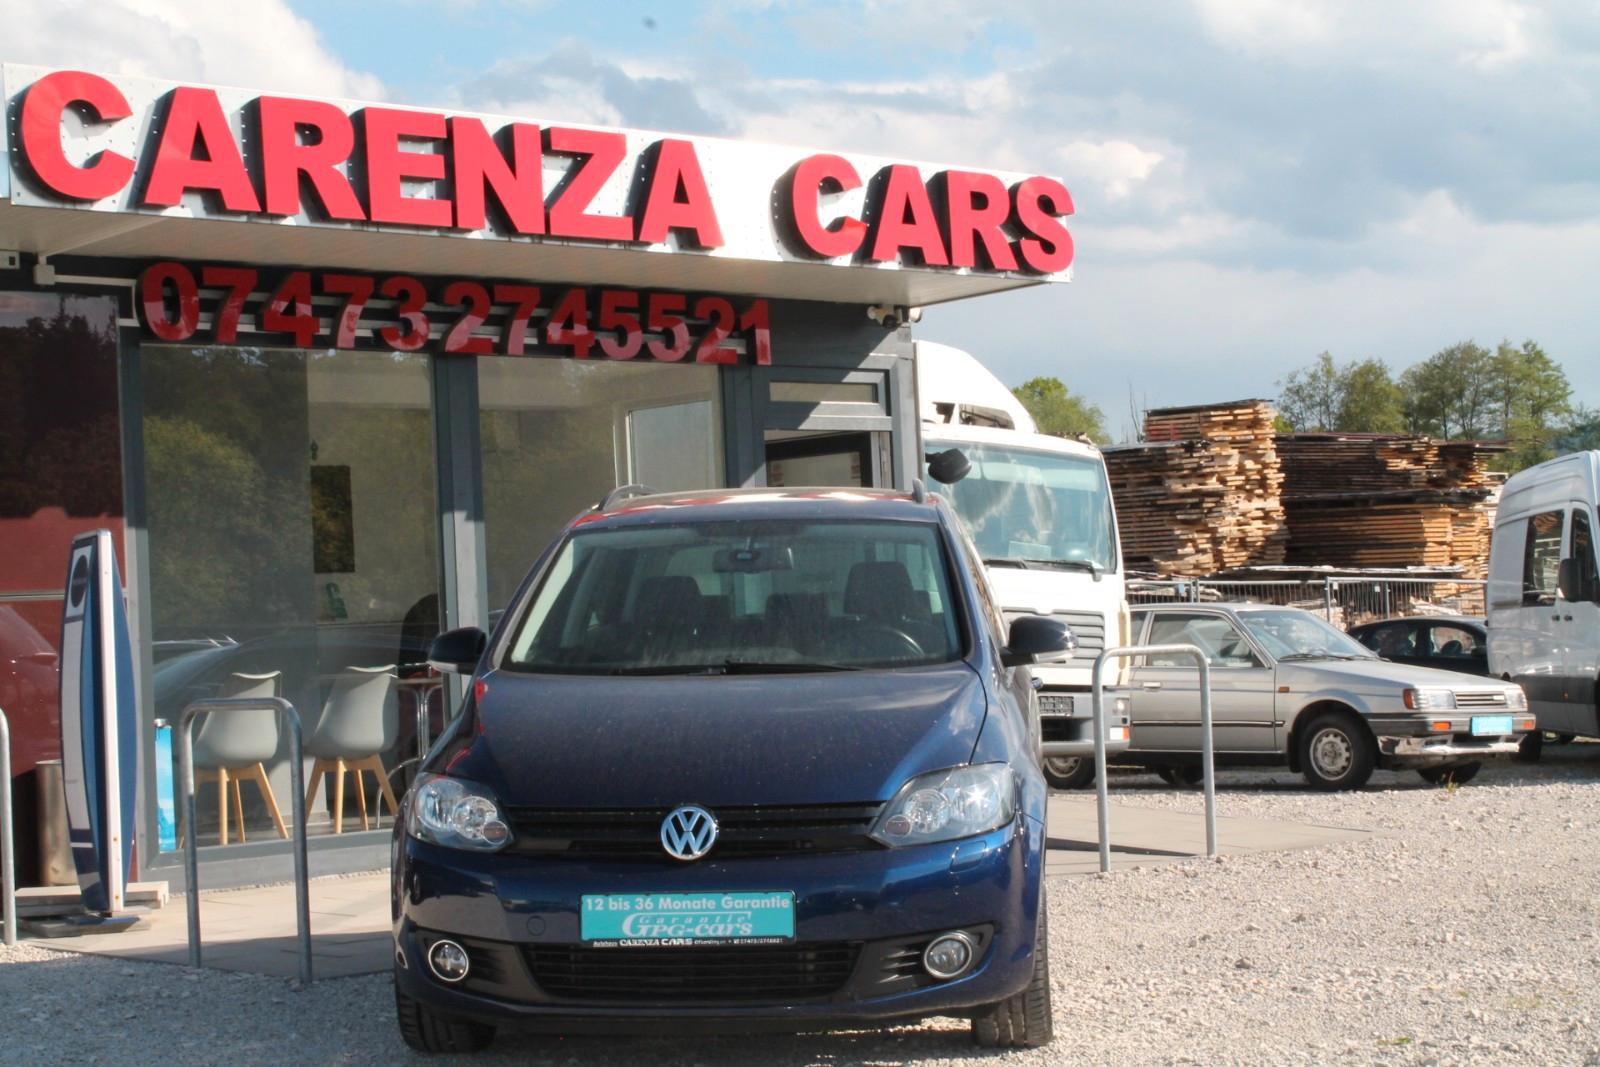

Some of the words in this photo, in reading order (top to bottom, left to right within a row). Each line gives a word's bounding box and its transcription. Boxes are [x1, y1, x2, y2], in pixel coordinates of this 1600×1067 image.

[17, 70, 723, 249] CARENZA
[784, 153, 1075, 275] CARS
[586, 897, 604, 911] 12
[608, 897, 631, 911] bis
[635, 896, 654, 911] 36
[658, 896, 716, 910] Monate
[720, 895, 790, 910] Garantie
[661, 937, 693, 946] CARS
